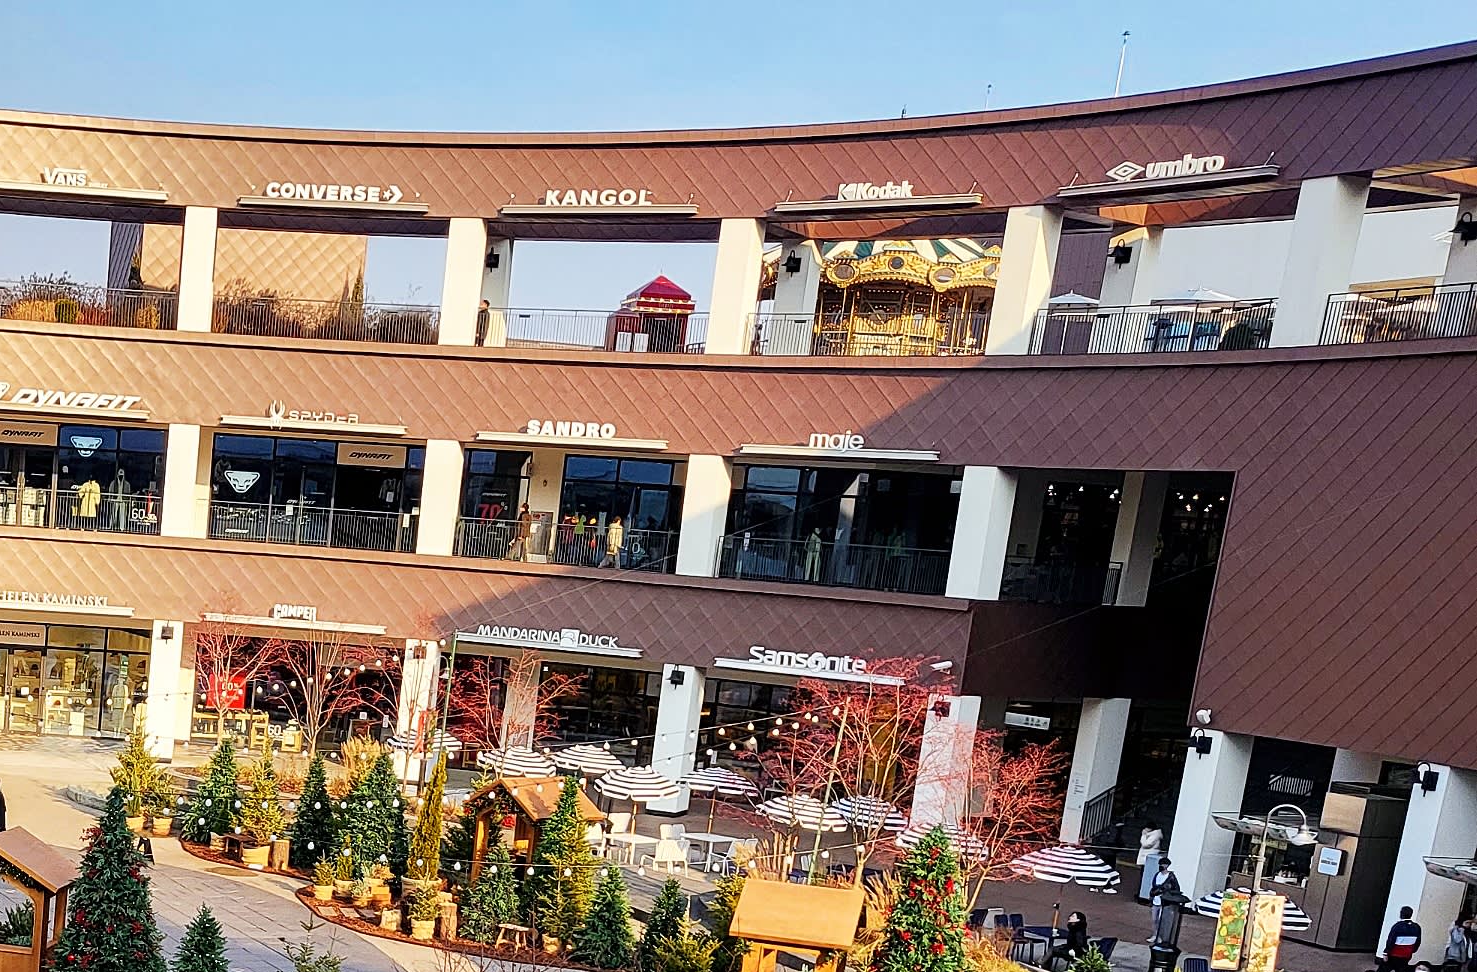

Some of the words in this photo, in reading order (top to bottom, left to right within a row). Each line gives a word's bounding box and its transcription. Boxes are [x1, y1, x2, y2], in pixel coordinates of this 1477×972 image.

[1145, 153, 1225, 179] umbro
[43, 167, 87, 187] VANS
[266, 182, 381, 203] CONVERSE
[545, 188, 652, 206] KANGOL
[856, 180, 914, 200] Kodak
[11, 388, 142, 410] DYNAFIT
[288, 410, 359, 424] SPYDER
[526, 419, 617, 439] SANDRO
[809, 430, 865, 453] maje
[43, 593, 109, 608] KAMINSKI
[476, 624, 560, 643] MANDARINA
[579, 633, 620, 648] DUCK
[748, 645, 867, 674] Samsonite
